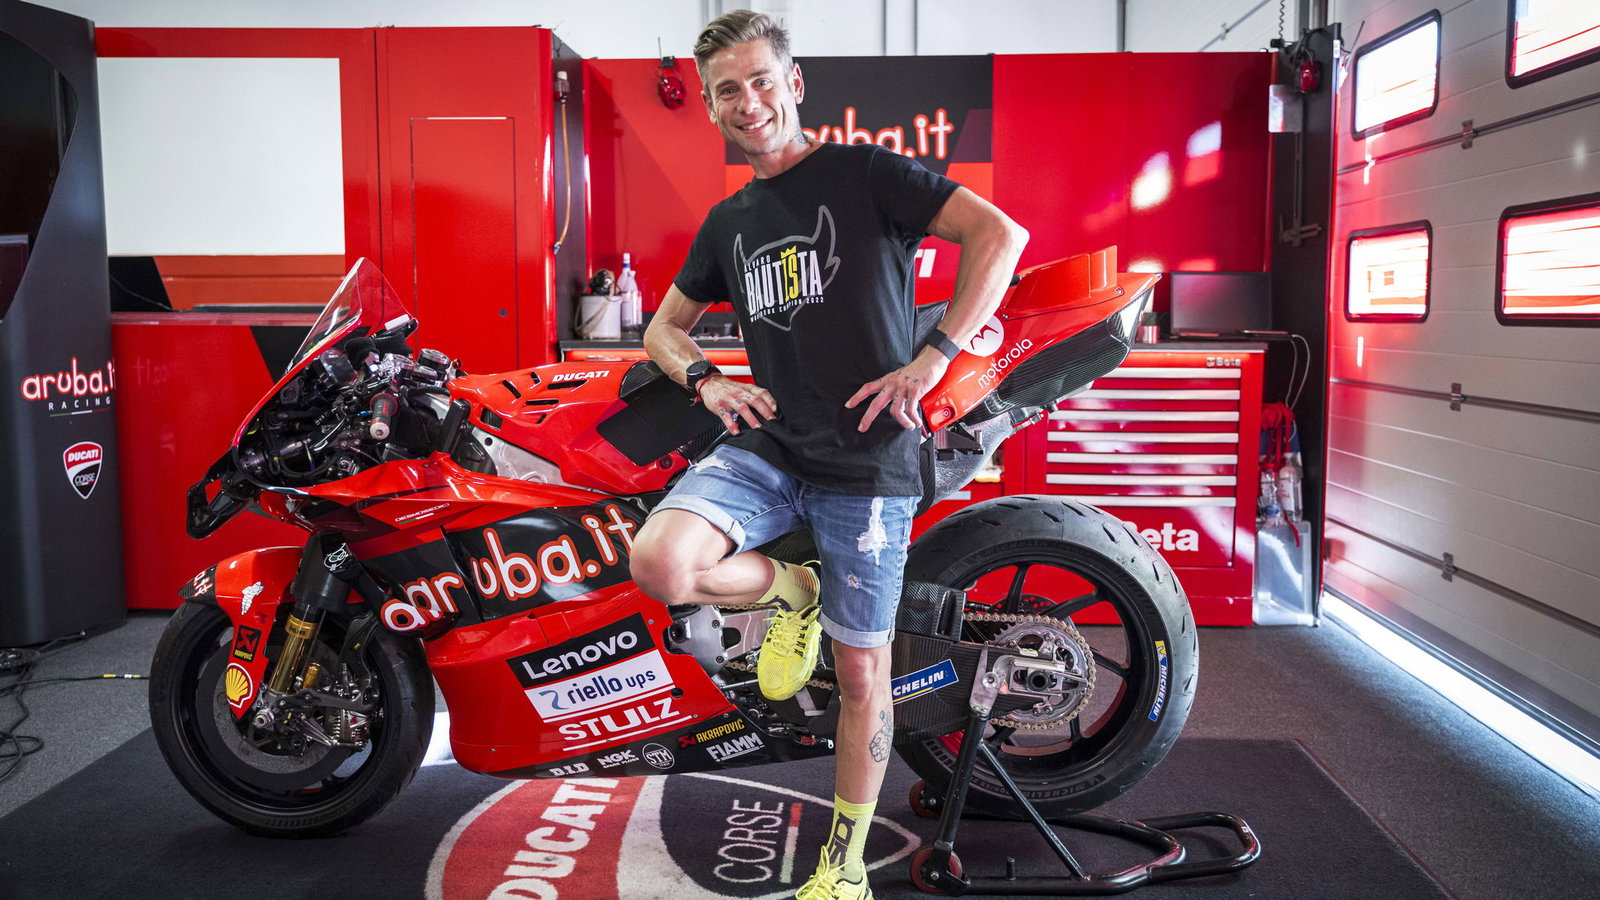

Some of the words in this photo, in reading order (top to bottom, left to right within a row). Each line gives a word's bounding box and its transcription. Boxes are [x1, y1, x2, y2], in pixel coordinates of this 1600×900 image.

[744, 250, 823, 316] BAUTISTA
[806, 296, 824, 304] 2022
[552, 370, 610, 382] DUCATI
[977, 339, 1034, 389] motorola
[1216, 357, 1242, 367] Beta
[21, 357, 116, 401] aruba.i
[48, 396, 111, 411] RACING
[68, 449, 99, 463] DUCATI
[74, 473, 96, 484] CORSE
[521, 630, 638, 680] Lenovo
[567, 675, 623, 704] riello
[626, 669, 656, 692] ups
[892, 669, 945, 696] CHELIN
[1153, 665, 1168, 716] MICHELIN
[558, 697, 680, 741] STULZ
[597, 749, 636, 766] NGK
[646, 750, 672, 764] STM
[705, 732, 764, 761] FIAMM
[486, 778, 620, 900] DUCATI
[713, 799, 784, 883] CORSE
